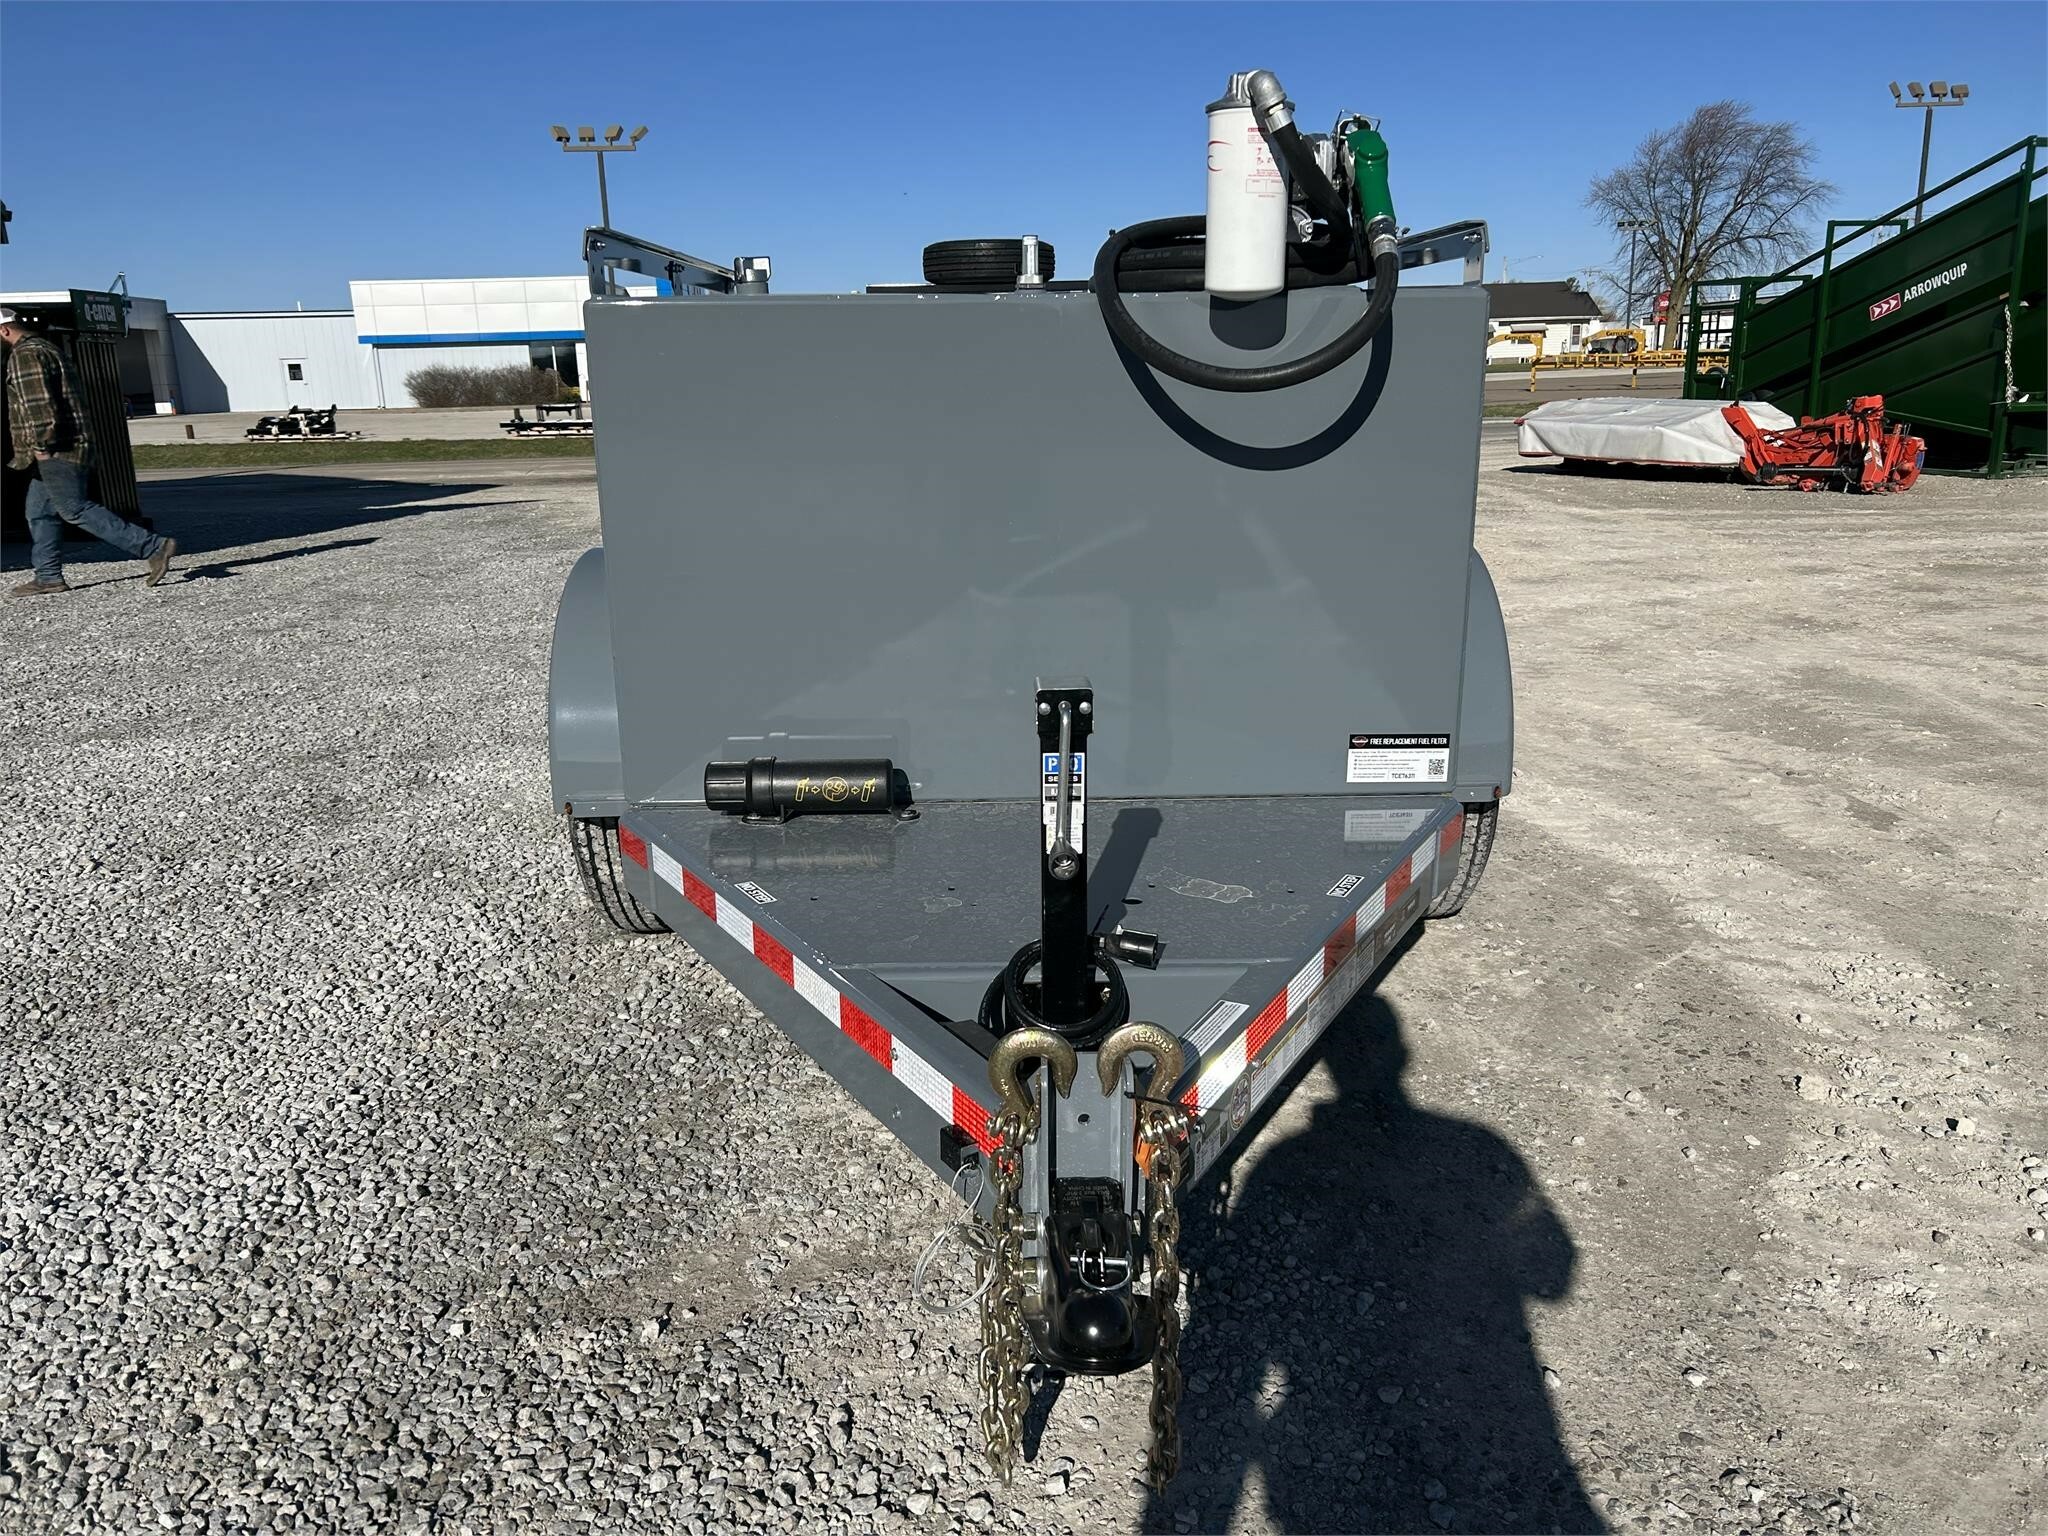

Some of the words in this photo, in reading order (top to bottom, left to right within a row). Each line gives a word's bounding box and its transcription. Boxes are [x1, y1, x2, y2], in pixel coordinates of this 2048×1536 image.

[1903, 262, 1968, 303] ARROWQUIP
[1370, 737, 1382, 745] FREE
[1383, 737, 1418, 745] REPLACEMENT
[1339, 876, 1359, 889] STEP
[748, 890, 771, 902] STEP
